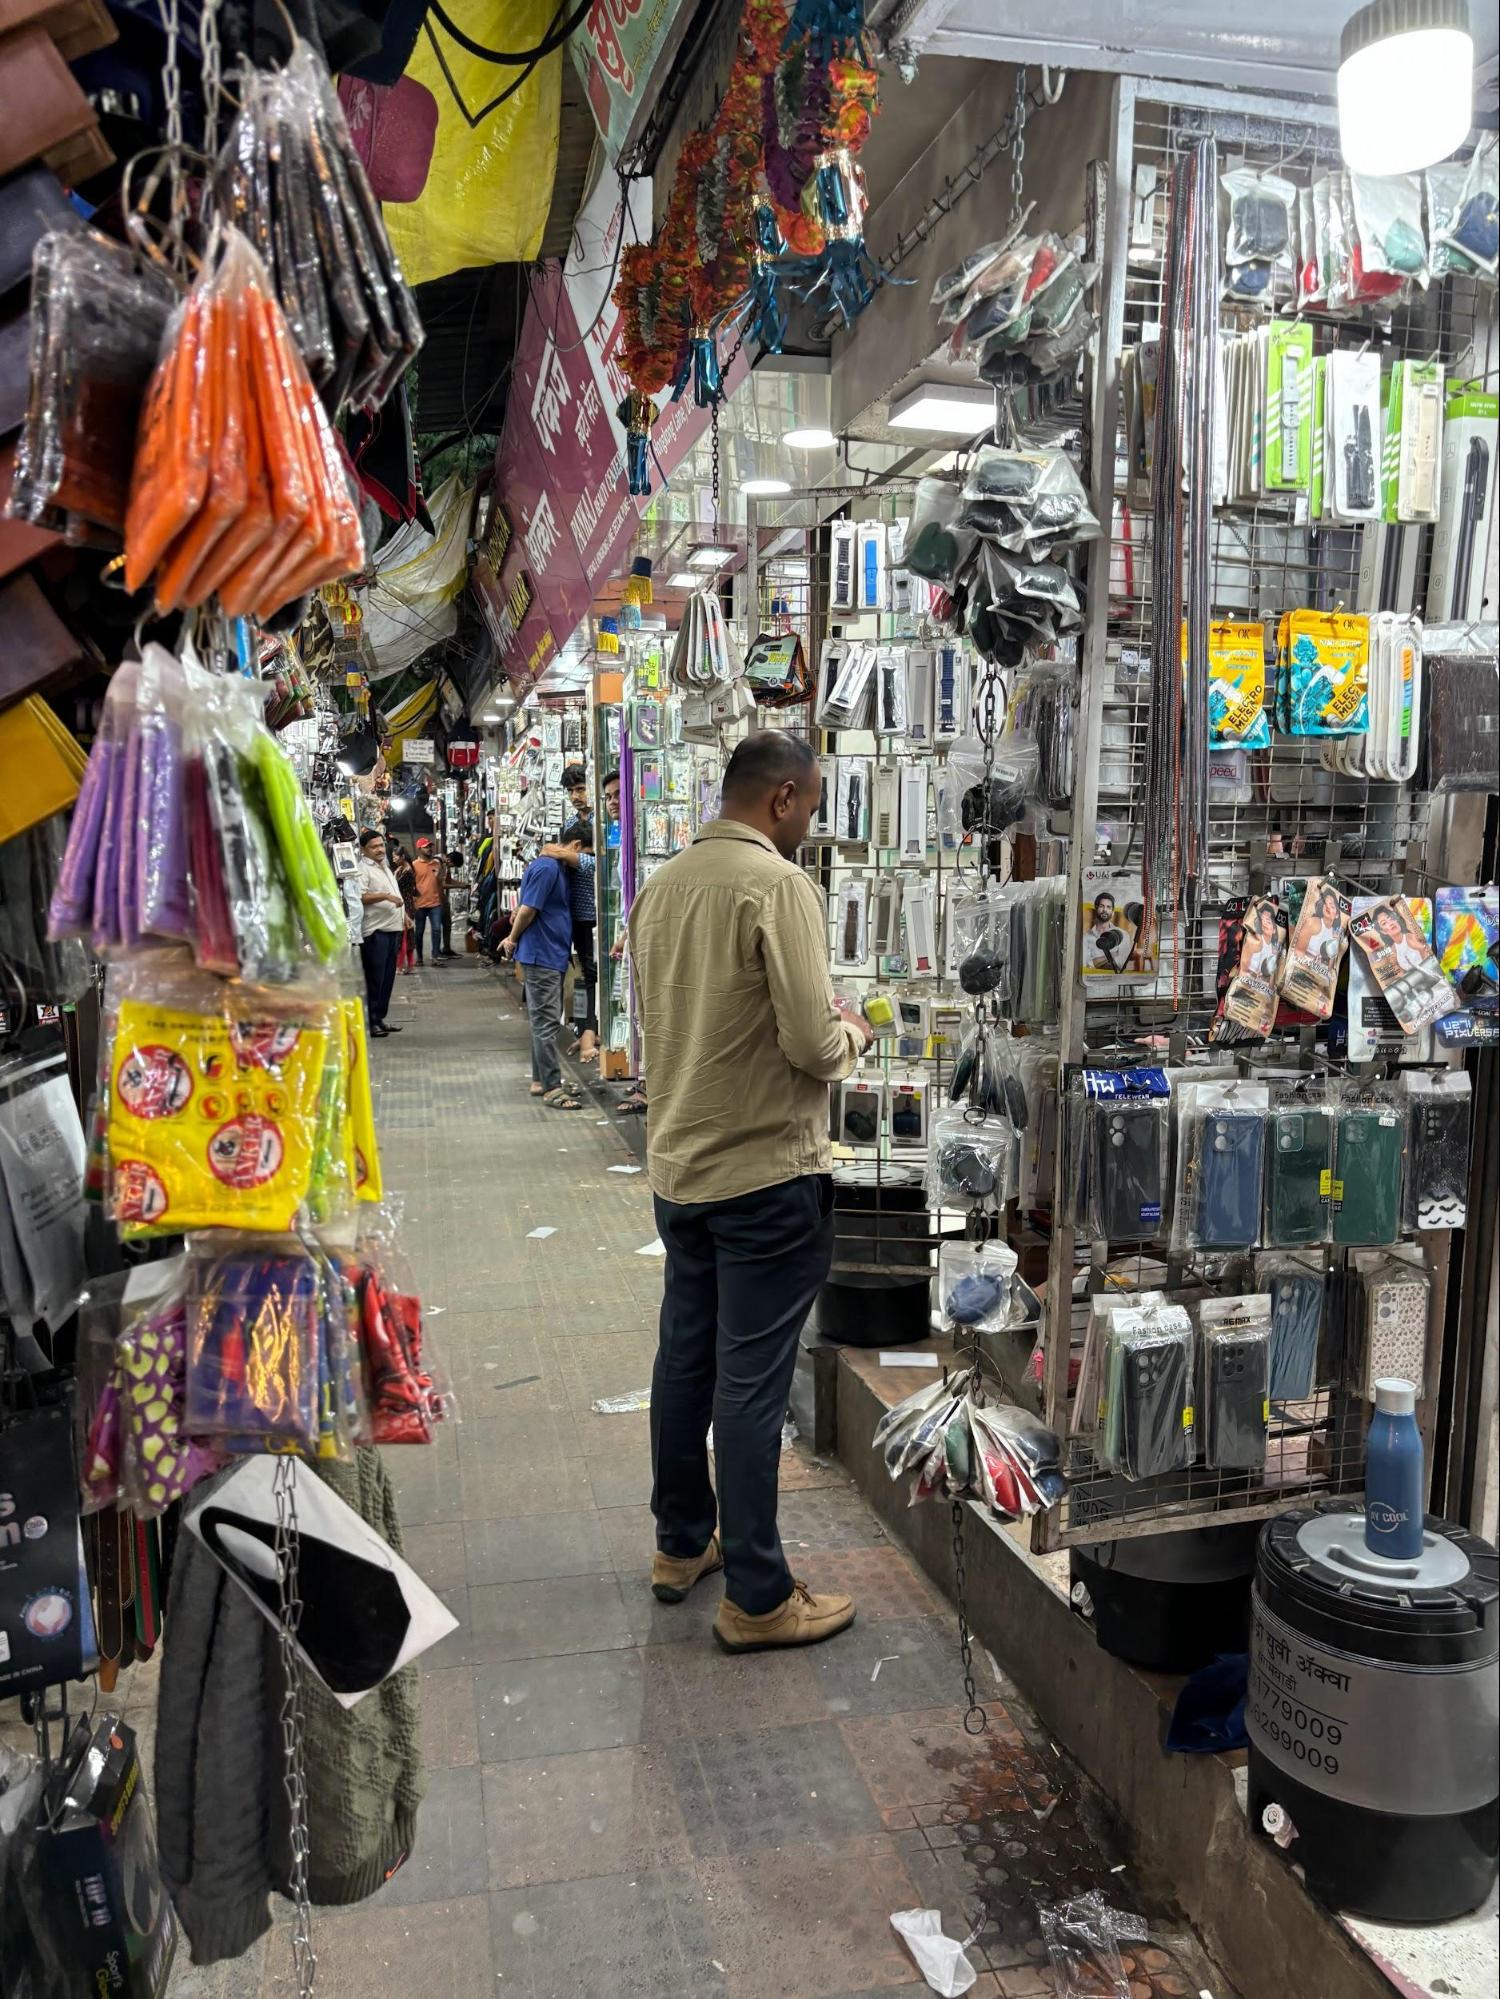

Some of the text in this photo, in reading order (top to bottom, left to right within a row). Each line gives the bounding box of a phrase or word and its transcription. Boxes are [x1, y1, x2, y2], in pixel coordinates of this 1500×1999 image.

[1228, 685, 1262, 724] ELECTRO
[1115, 1093, 1150, 1101] TELEWEAR
[1132, 1321, 1184, 1336] Fashion case
[1382, 1511, 1409, 1522] COOL
[83, 1872, 112, 1927] TOP 10
[106, 1950, 121, 1989] Sport's
